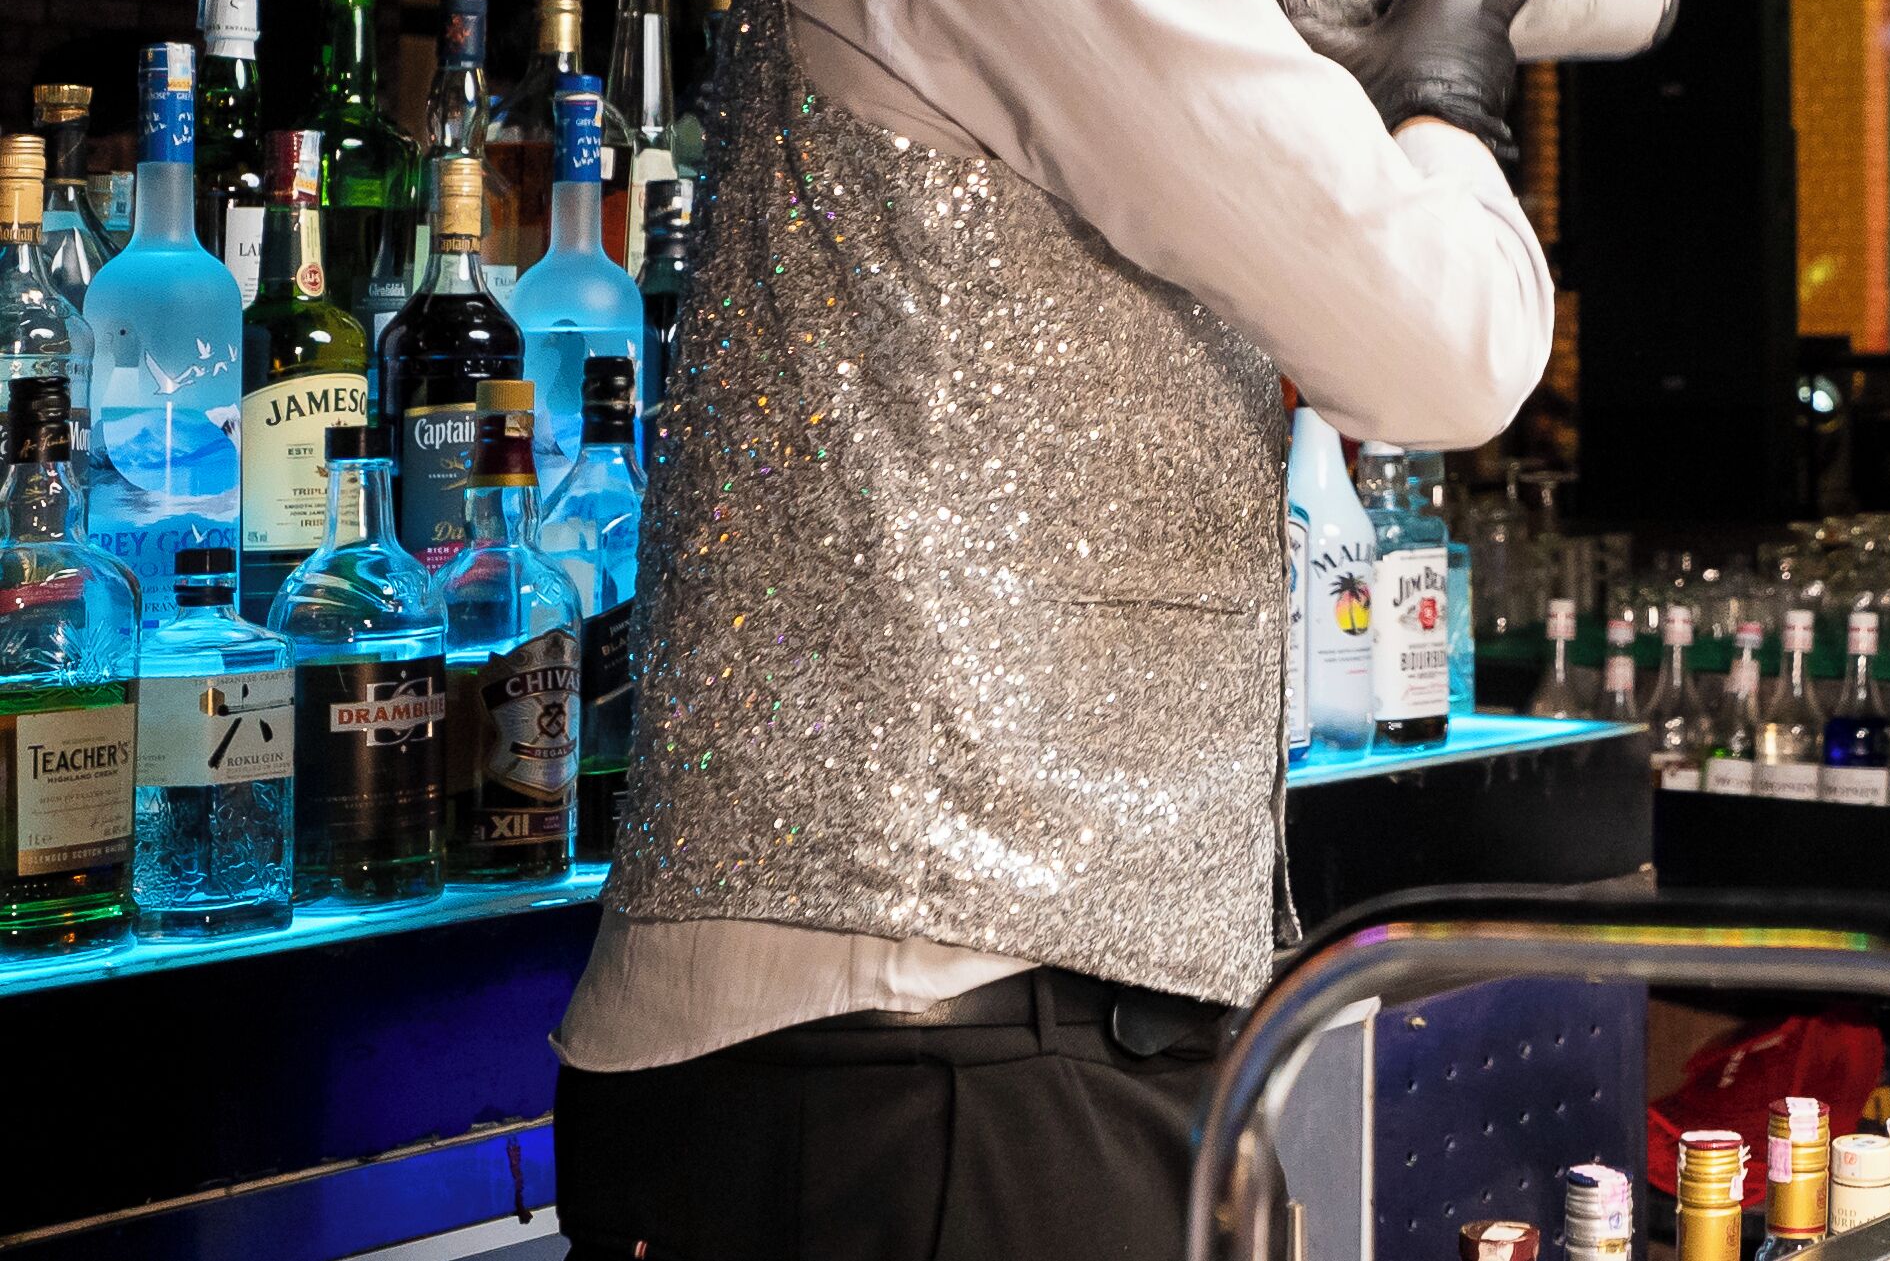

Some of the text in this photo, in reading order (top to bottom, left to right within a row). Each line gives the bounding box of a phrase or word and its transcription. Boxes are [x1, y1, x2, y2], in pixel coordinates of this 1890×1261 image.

[28, 740, 130, 780] TEACHER'S
[227, 752, 283, 767] ROKU GIN
[534, 748, 567, 758] REGAL
[490, 813, 529, 839] XII
